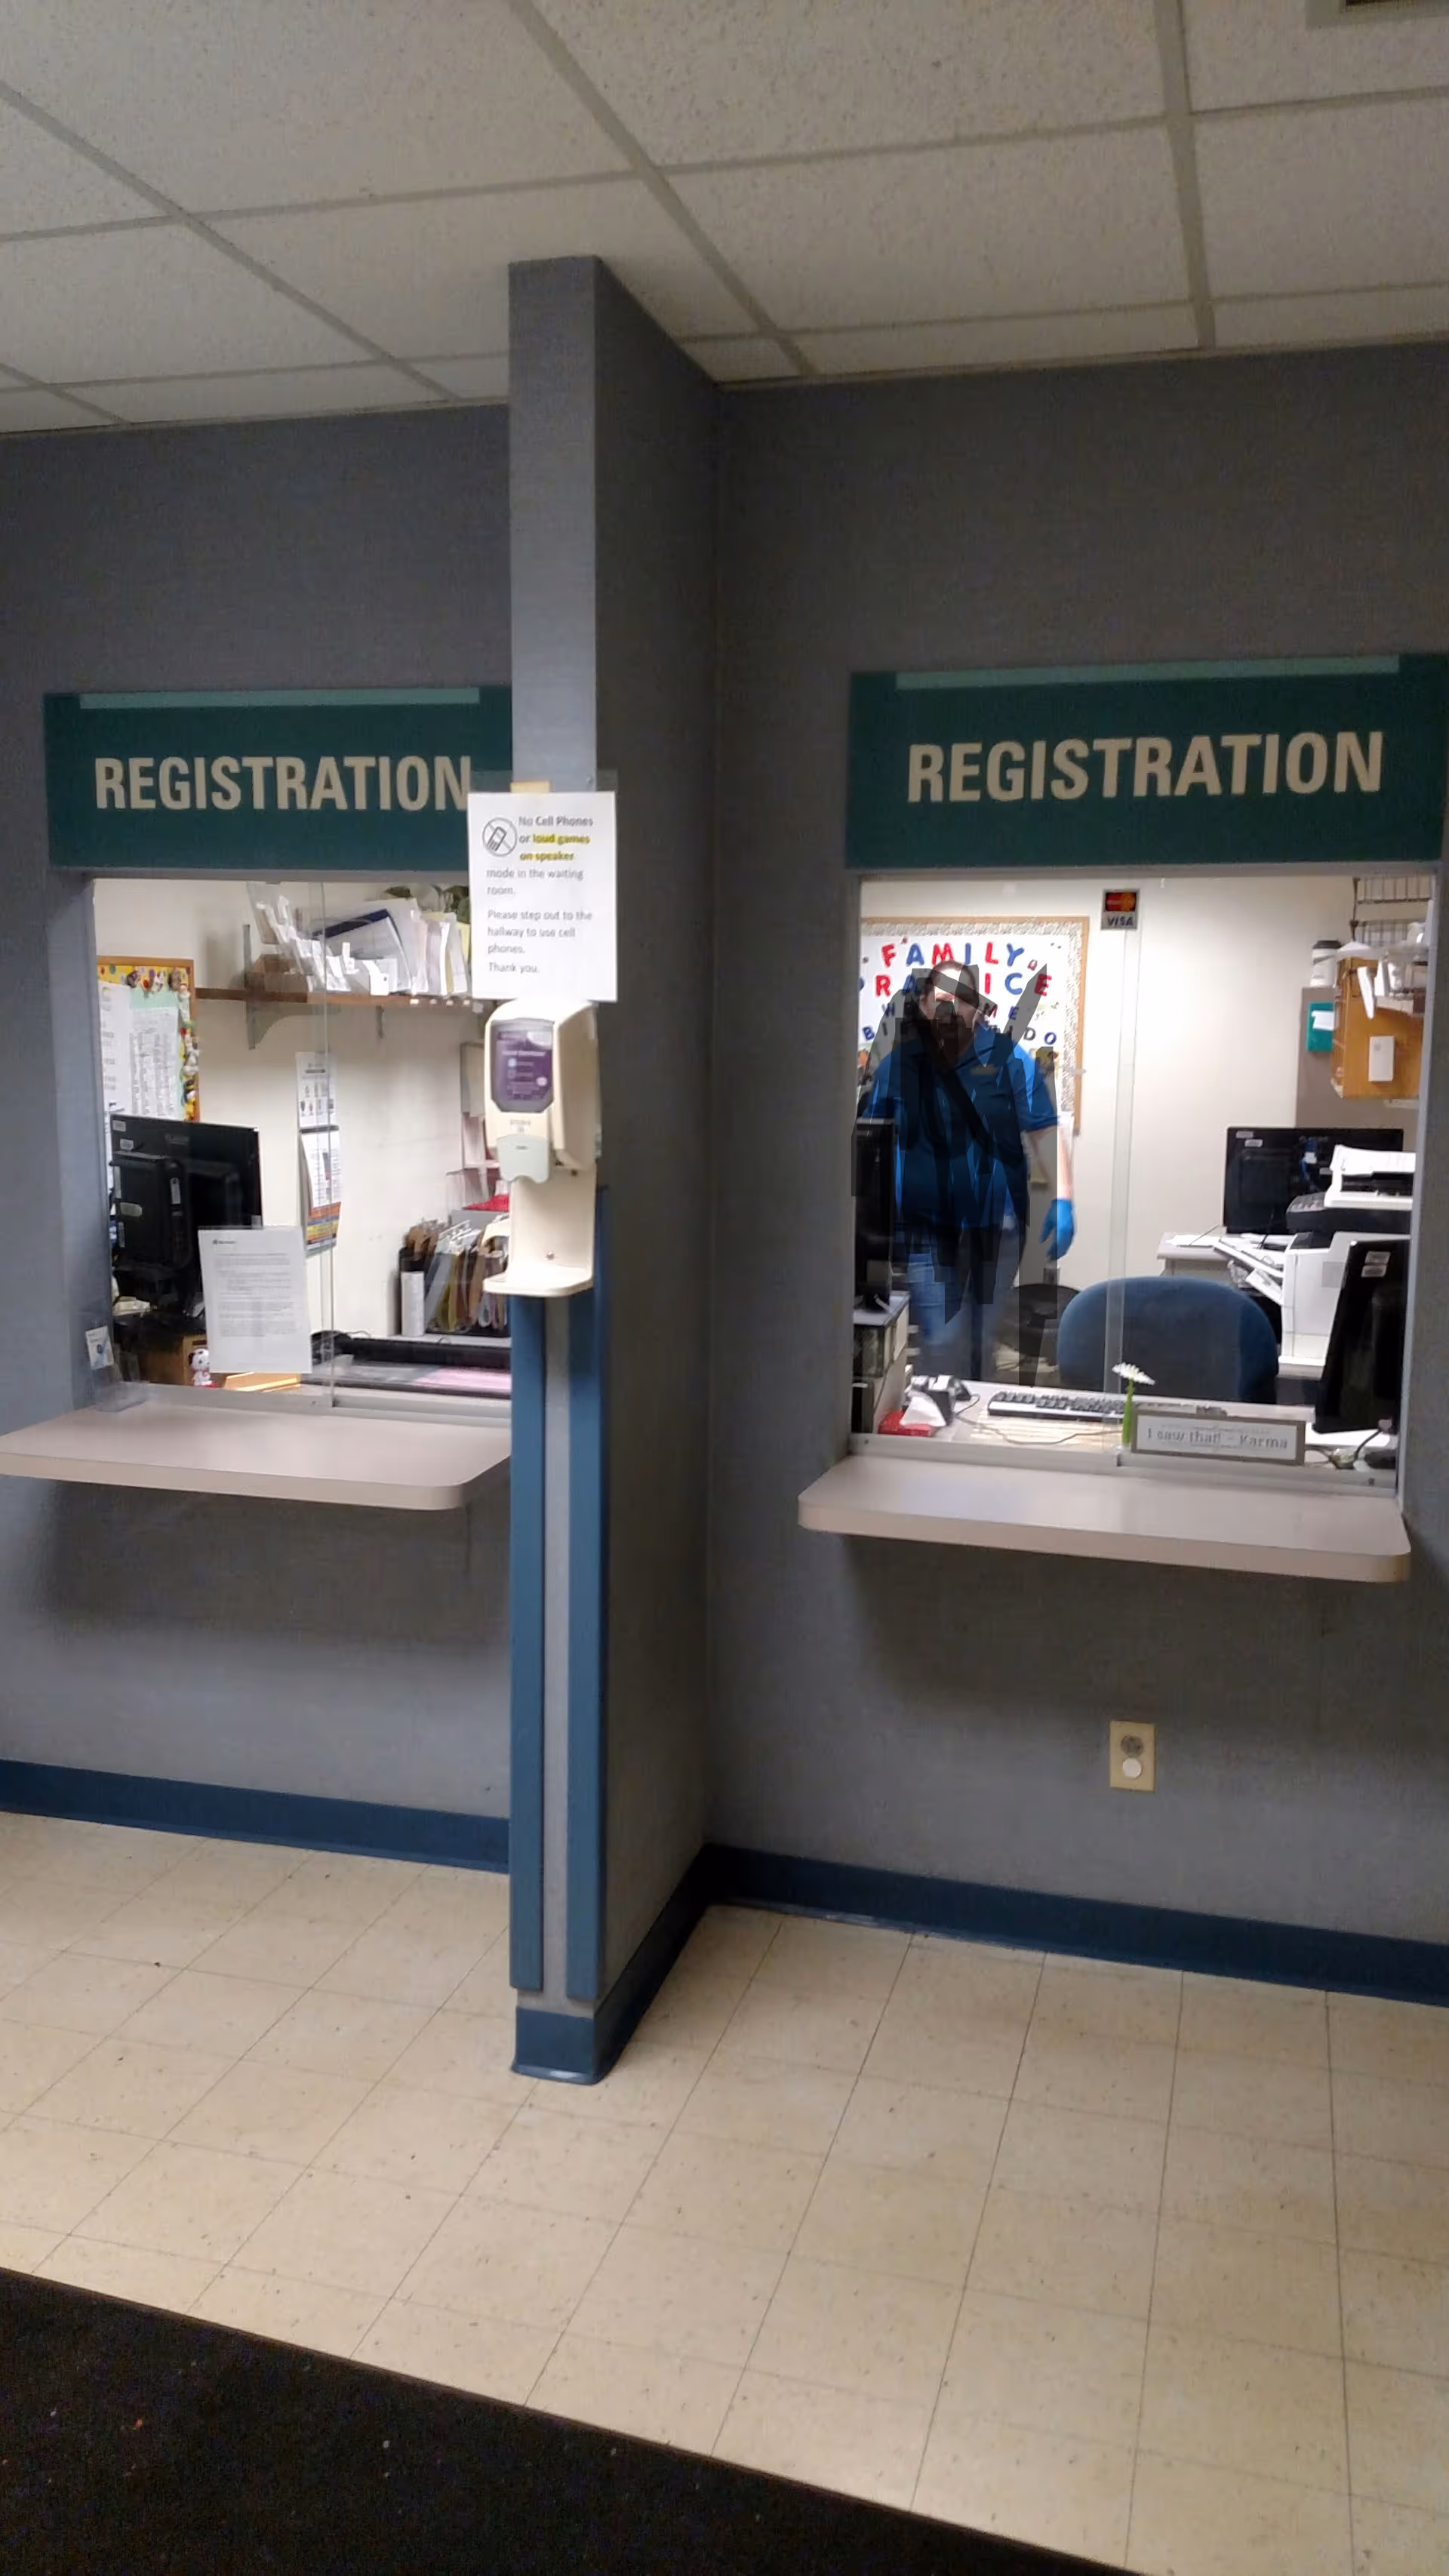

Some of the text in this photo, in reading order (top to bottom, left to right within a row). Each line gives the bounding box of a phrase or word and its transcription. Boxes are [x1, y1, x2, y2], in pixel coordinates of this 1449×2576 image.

[908, 731, 1383, 802] REGISTRATION
[95, 756, 471, 811] REGISTRATION
[518, 815, 593, 826] No Cell Phones
[518, 833, 590, 845] or loud games
[535, 851, 574, 863] speaker
[486, 867, 584, 882] mode in the waiting
[488, 909, 592, 922] Please step out to the
[1107, 916, 1134, 926] VISA
[488, 926, 575, 938] hallway to use cell
[488, 943, 525, 954] phones.
[881, 942, 1024, 968] FAMILY
[489, 962, 516, 972] Thank
[1157, 1432, 1183, 1442] saw
[1240, 1435, 1287, 1448] Karma
